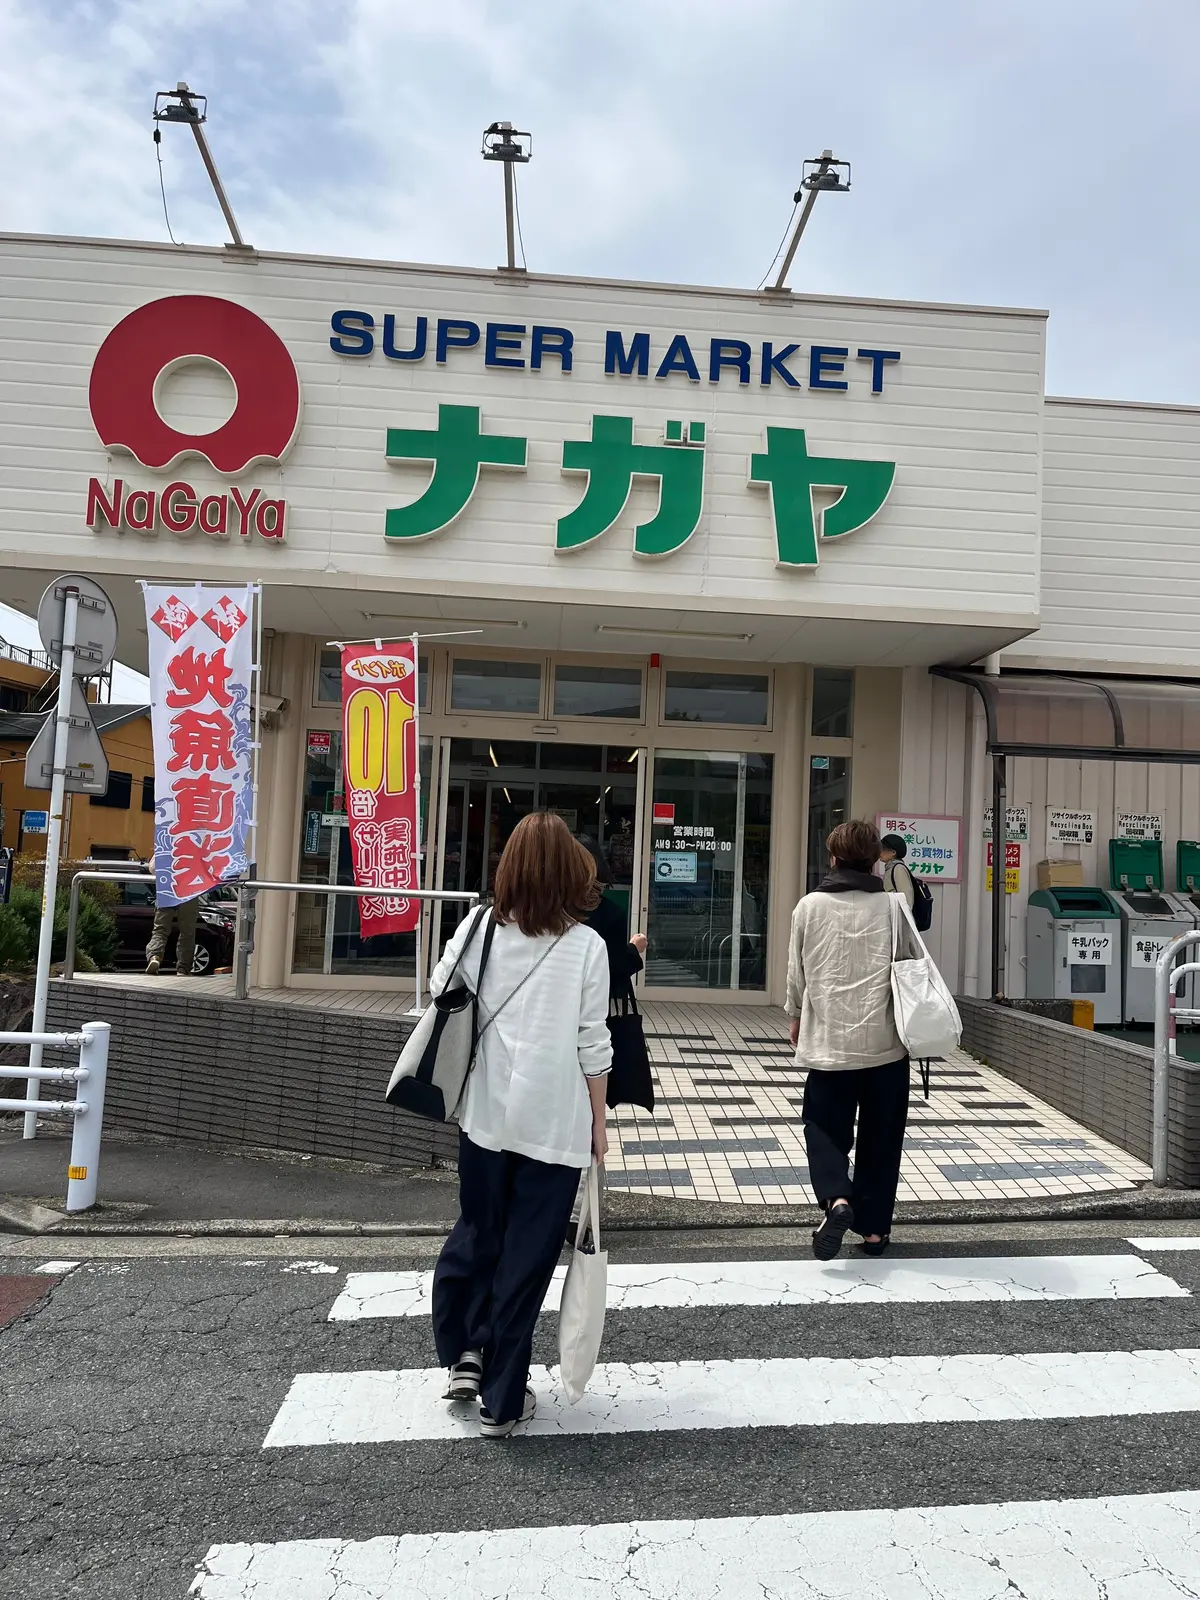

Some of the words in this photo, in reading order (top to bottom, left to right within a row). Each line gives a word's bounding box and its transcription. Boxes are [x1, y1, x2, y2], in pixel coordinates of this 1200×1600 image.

[329, 309, 575, 374] SUPER
[603, 330, 901, 395] MARKET
[384, 403, 897, 568] ナガヤ
[85, 477, 288, 541] NaGaYa
[1051, 811, 1092, 820] リサイクルボックス
[1119, 814, 1160, 822] リサイクルボックス
[886, 820, 917, 831] 明るく
[1050, 820, 1081, 829] Recycling
[1118, 820, 1149, 829] Recycling
[673, 826, 714, 837] 営業時間
[904, 833, 936, 845] 楽しい
[911, 847, 953, 859] お買物は
[908, 862, 944, 874] ナガヤ
[1071, 936, 1109, 948] 牛乳パック
[1136, 941, 1165, 952] 食品トレ
